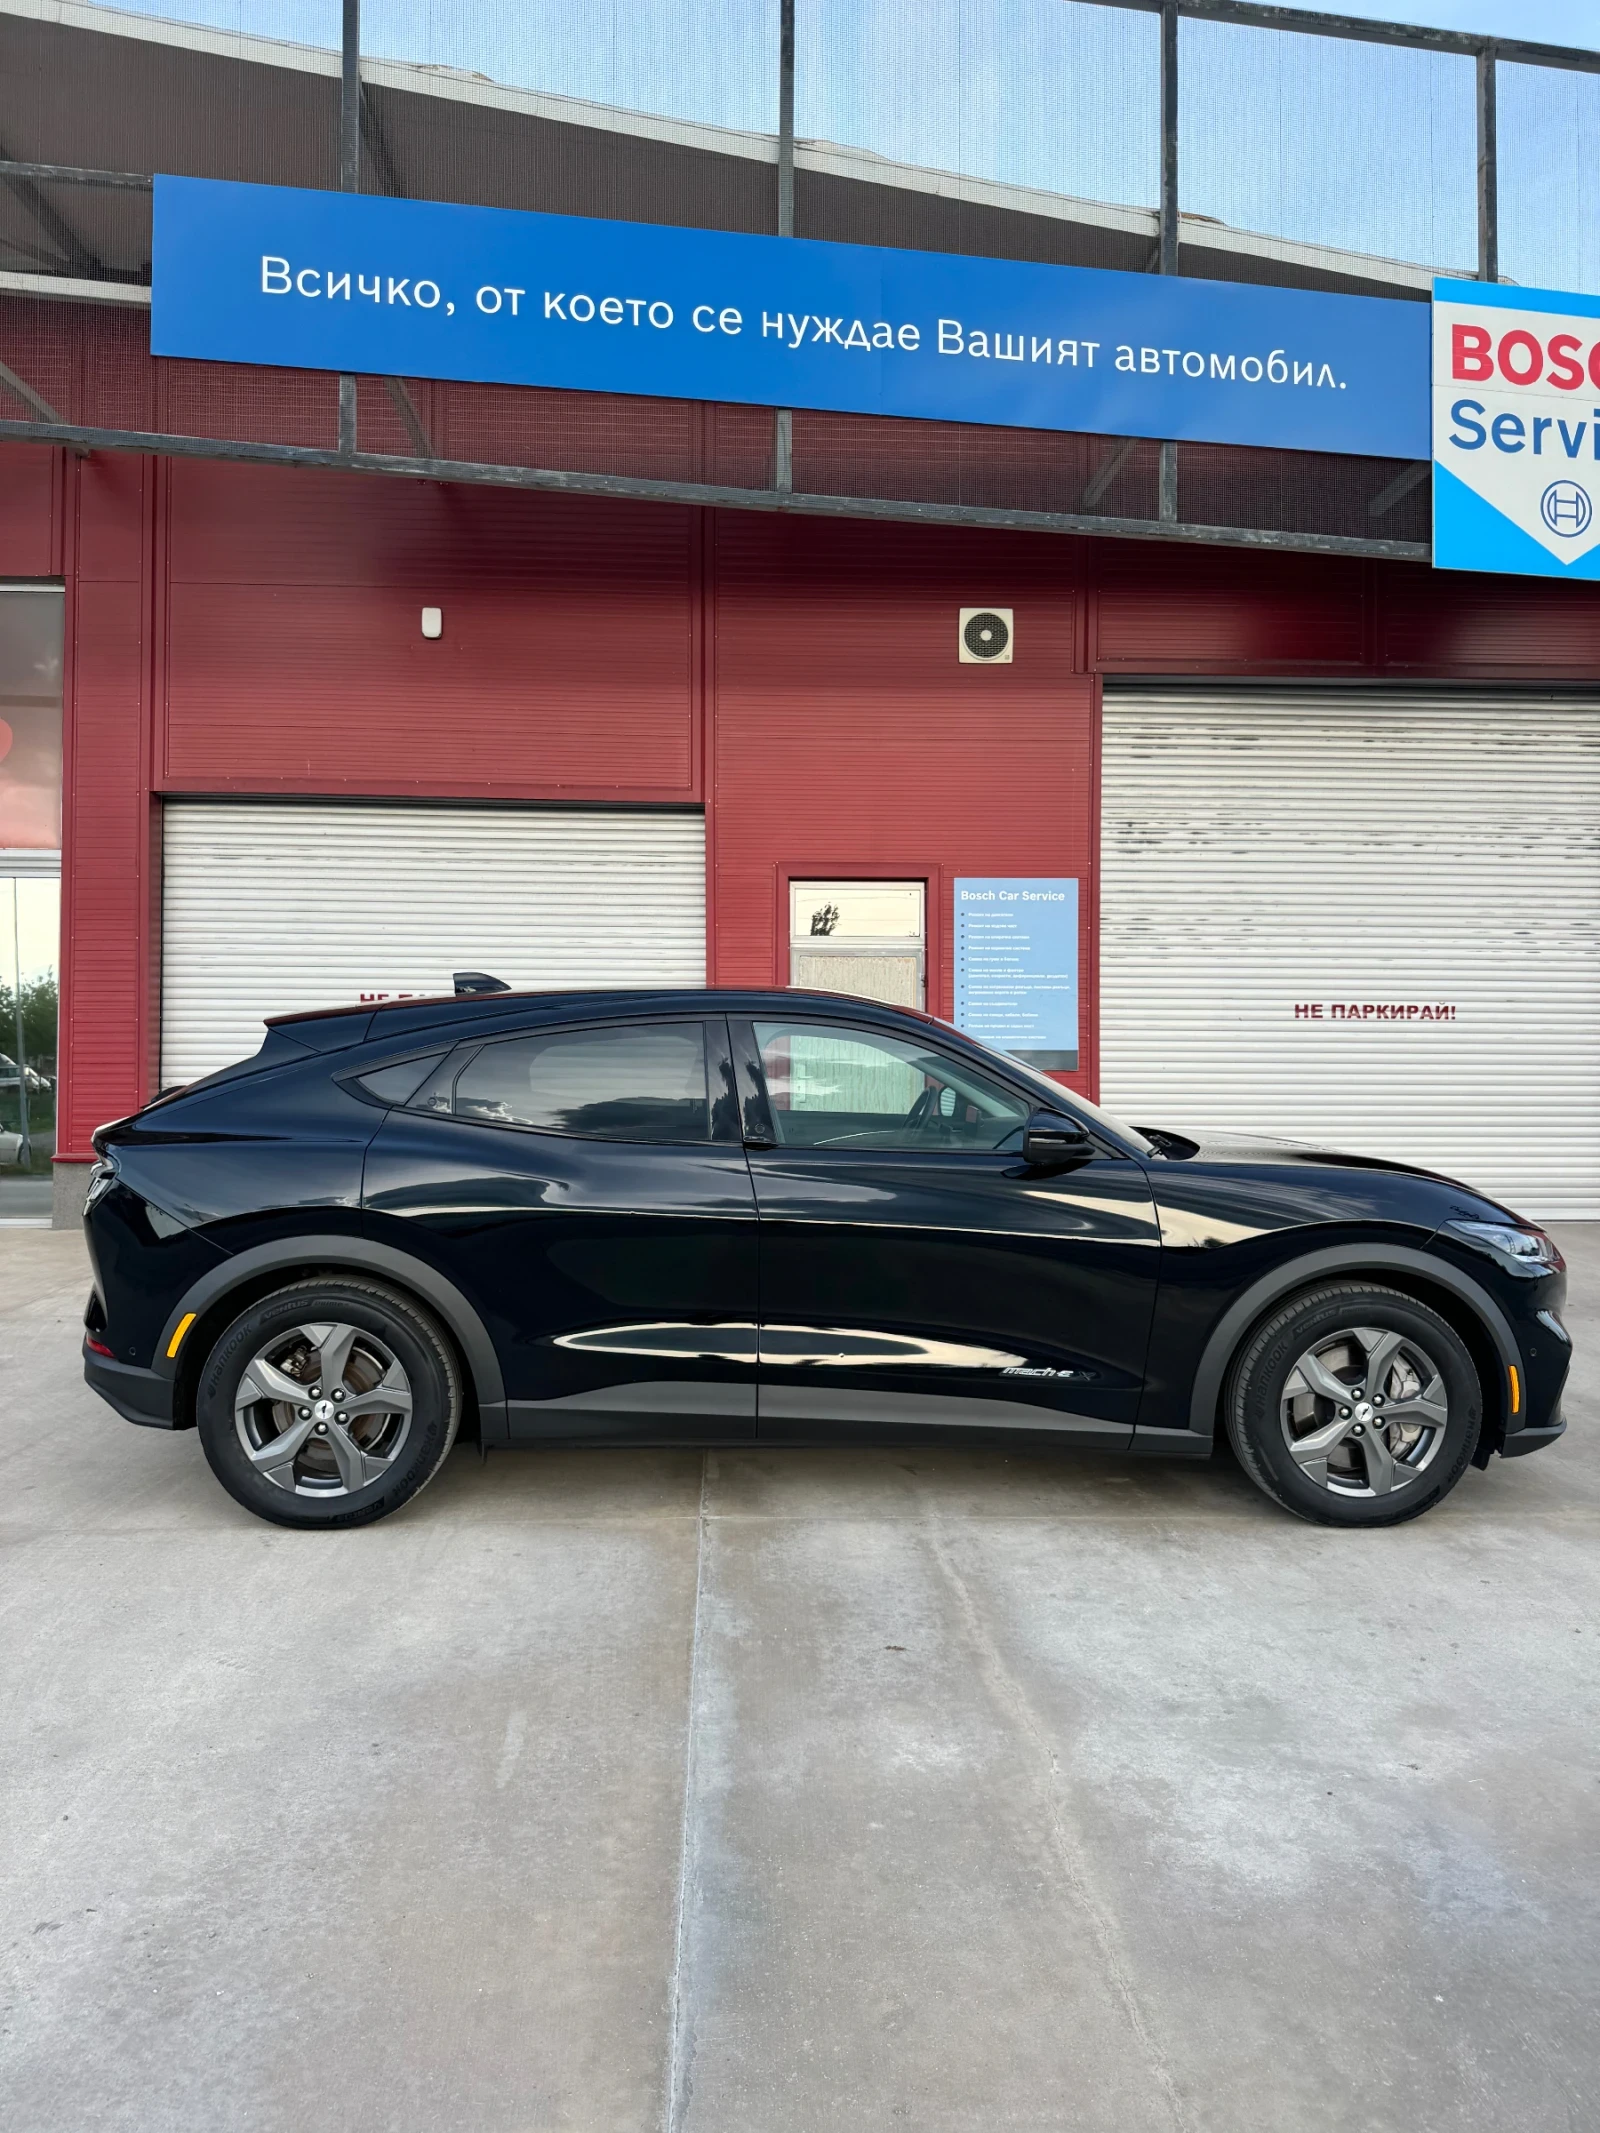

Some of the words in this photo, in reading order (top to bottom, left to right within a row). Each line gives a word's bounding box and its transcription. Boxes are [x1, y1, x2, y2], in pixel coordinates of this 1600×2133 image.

[260, 255, 455, 316] Всичко,
[475, 285, 526, 316] от
[543, 291, 675, 329] което
[692, 305, 743, 335] се
[761, 311, 920, 352] нуждае
[937, 318, 1101, 368] Вашият
[1113, 345, 1347, 390] автомобил.
[1451, 323, 1600, 390] BOS
[960, 890, 996, 901] Bosch
[998, 890, 1020, 901] Car
[1022, 890, 1065, 901] Service
[1294, 1004, 1324, 1019] НЕ
[1331, 1002, 1457, 1020] ПАРКИРАЙ!
